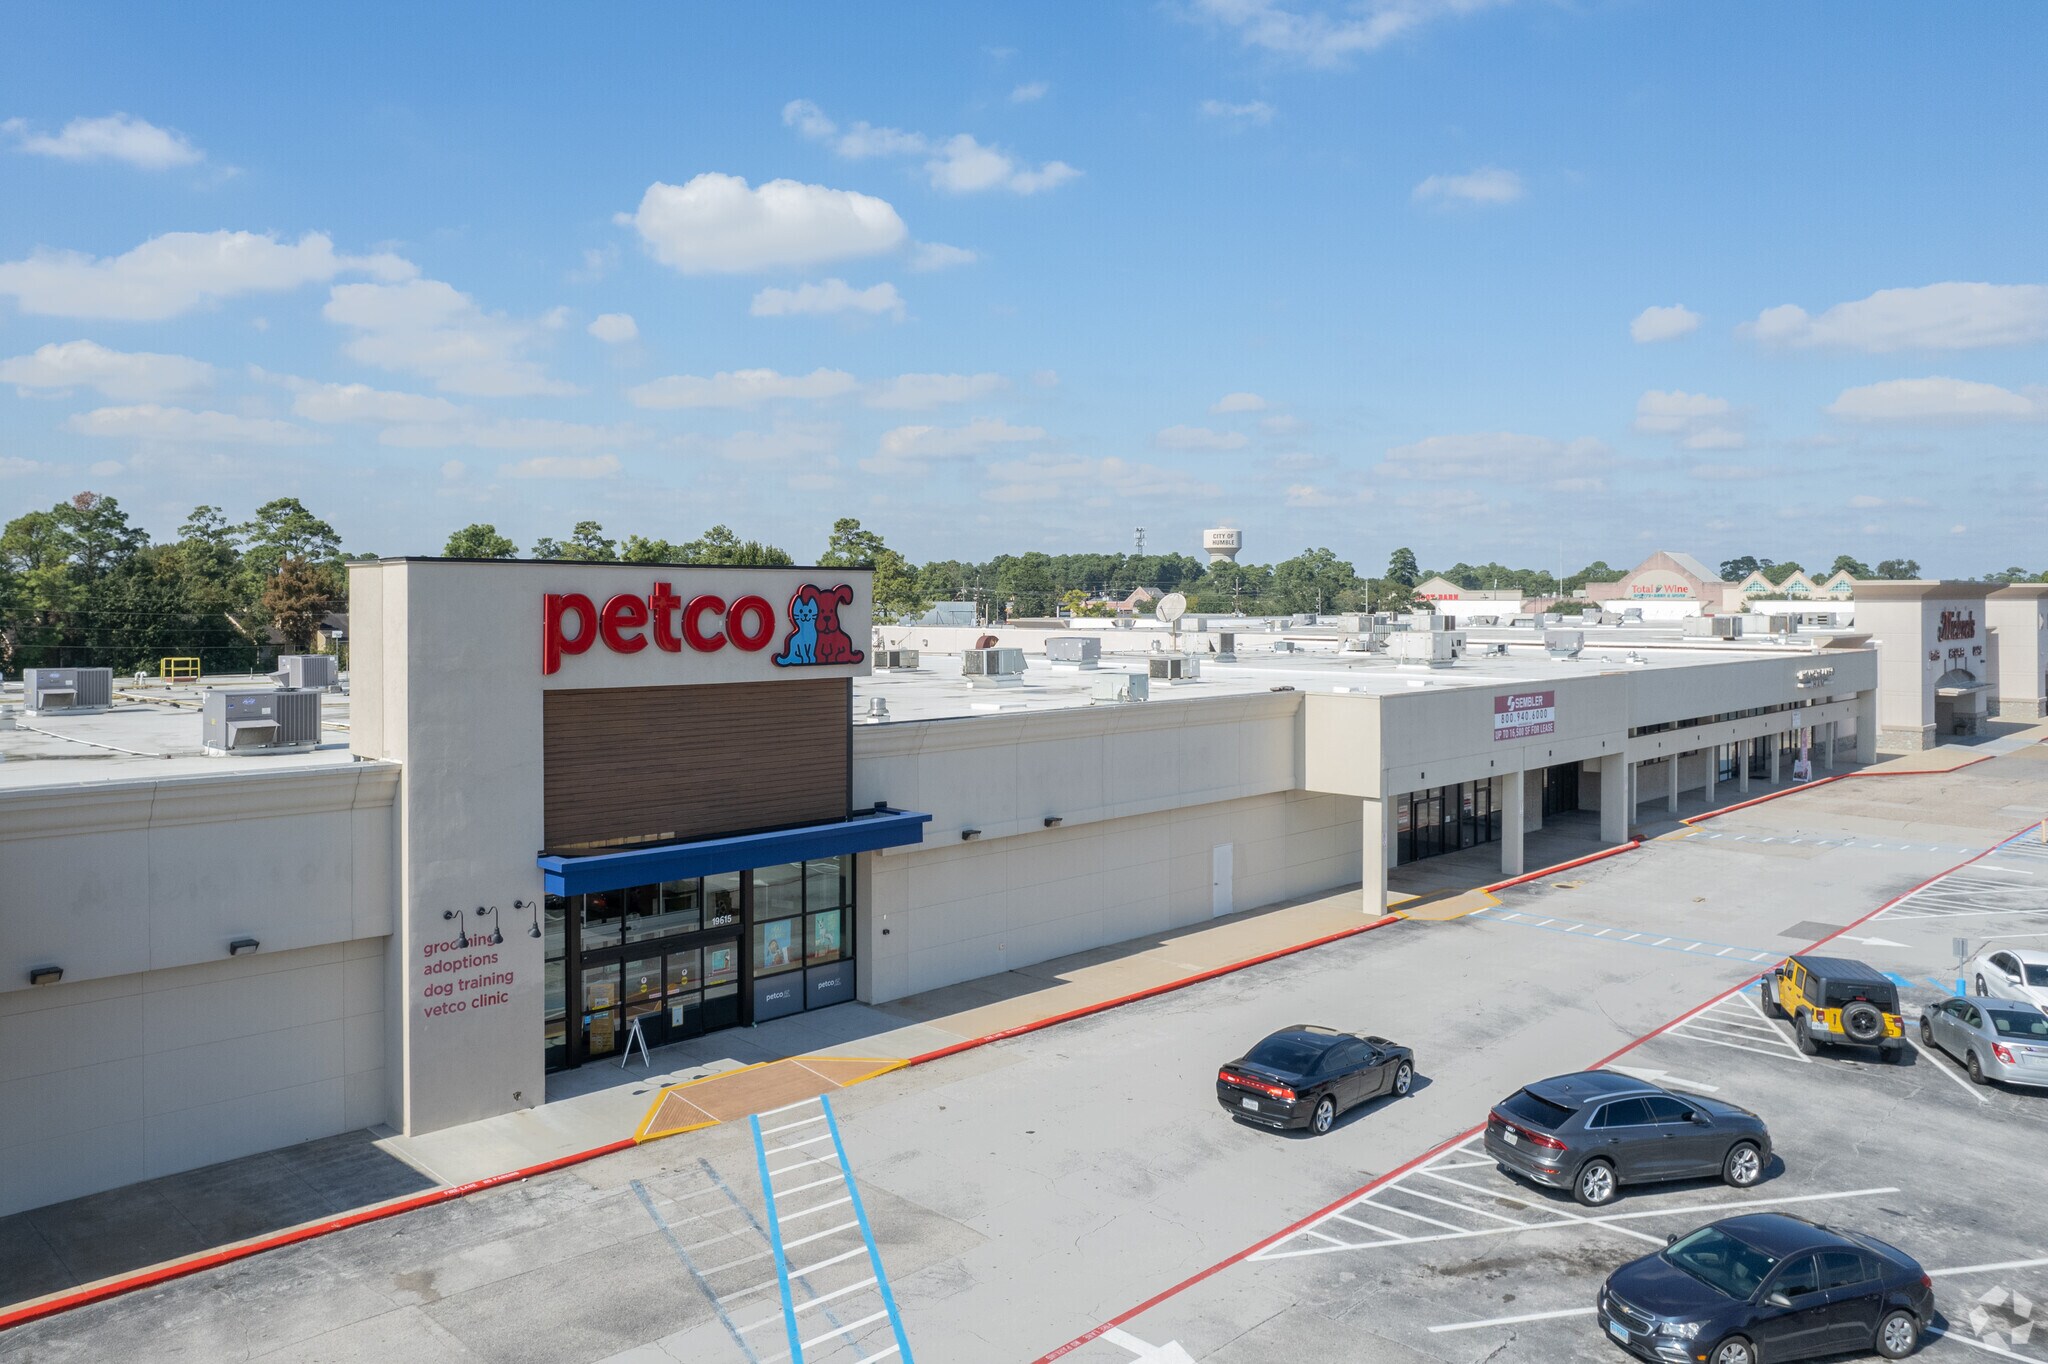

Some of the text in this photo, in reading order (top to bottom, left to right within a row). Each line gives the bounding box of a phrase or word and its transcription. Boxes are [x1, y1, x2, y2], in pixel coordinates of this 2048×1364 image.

[1632, 584, 1689, 593] Total Wine
[543, 582, 776, 675] petco
[1515, 695, 1543, 708] SEMBLER
[1501, 709, 1547, 724] 800.940.6000
[1531, 725, 1540, 735] FOR
[1540, 722, 1553, 733] LEASE
[712, 914, 732, 926] 19615
[423, 934, 497, 957] grooing
[423, 953, 498, 976] adoptions
[423, 971, 514, 997] dog training
[817, 979, 835, 991] petco
[766, 991, 783, 1002] petco
[423, 990, 509, 1018] vetco clinic
